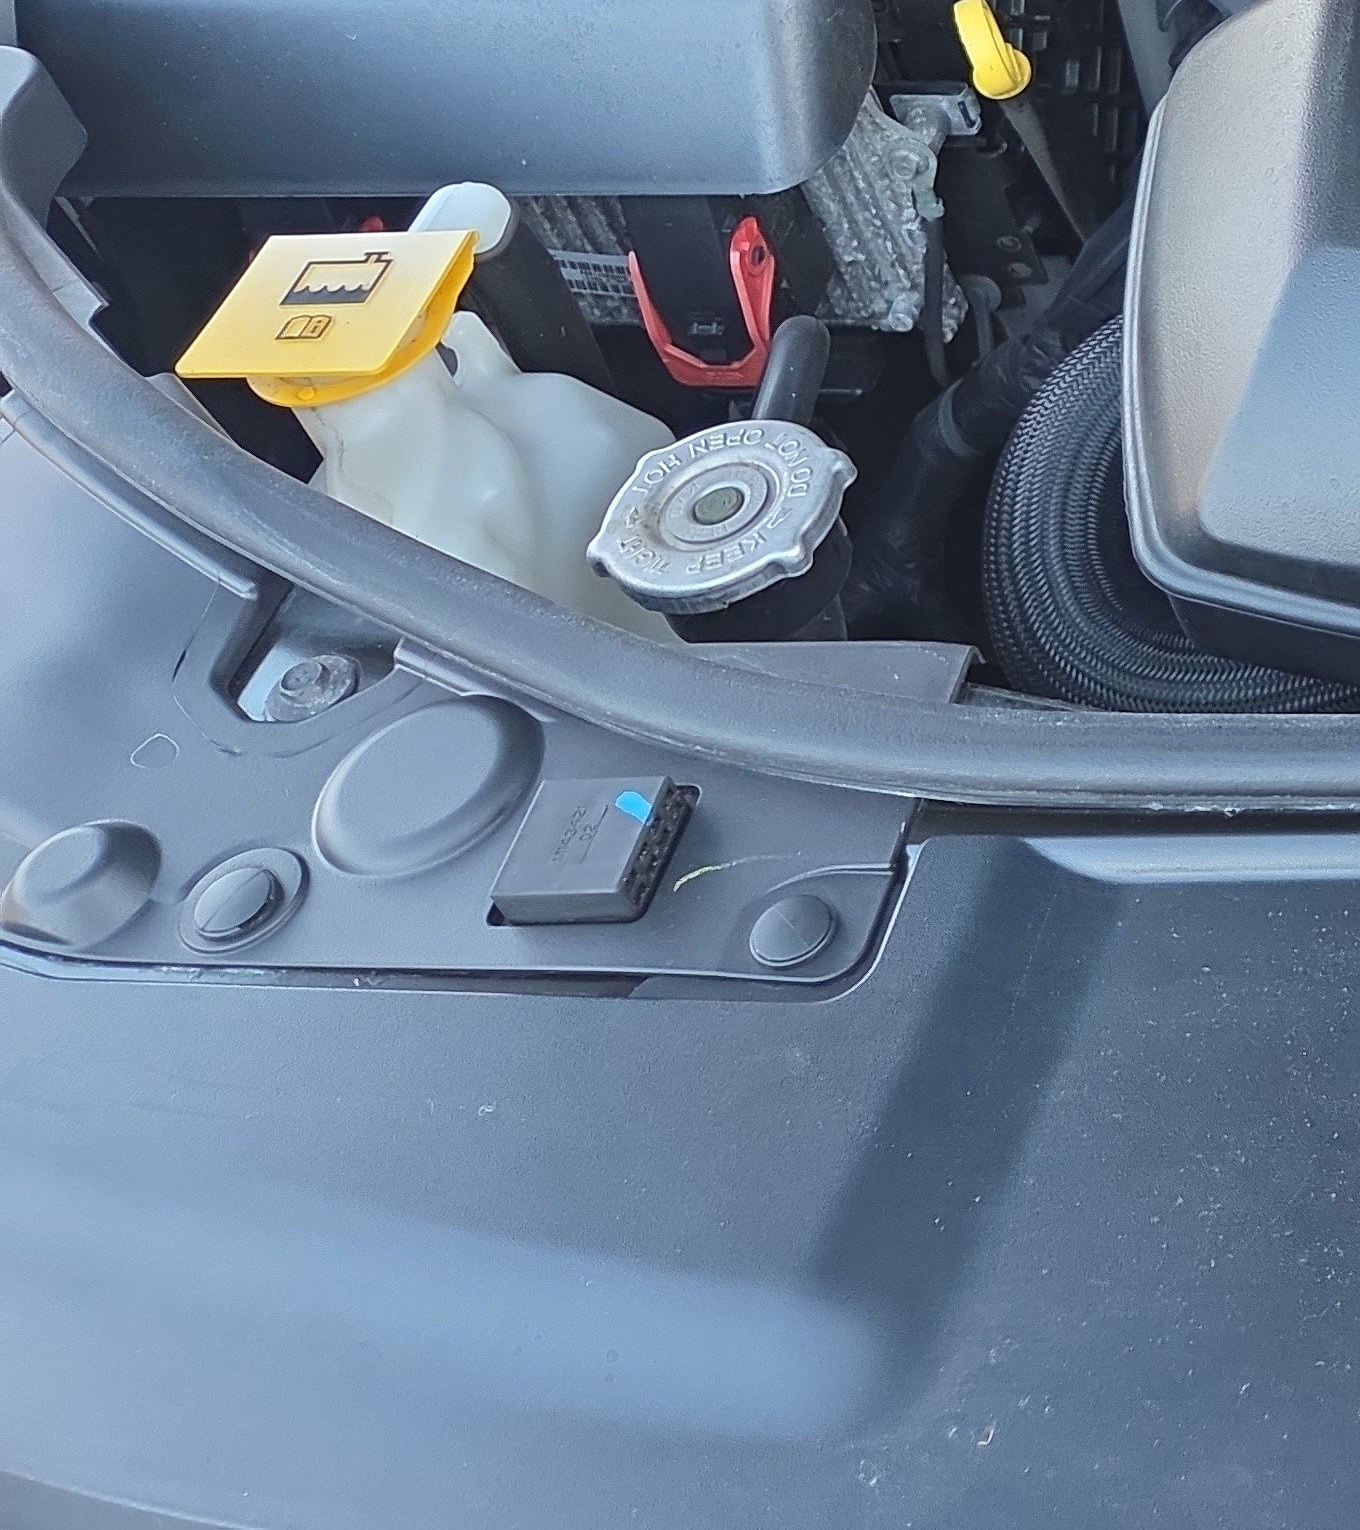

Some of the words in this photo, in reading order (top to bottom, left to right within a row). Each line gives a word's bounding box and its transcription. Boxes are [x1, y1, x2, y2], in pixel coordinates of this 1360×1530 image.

[687, 427, 765, 460] OPEN
[763, 431, 806, 468] NOT
[631, 452, 683, 497] HOT
[616, 536, 672, 576] TIGHT
[684, 531, 768, 575] KEEP
